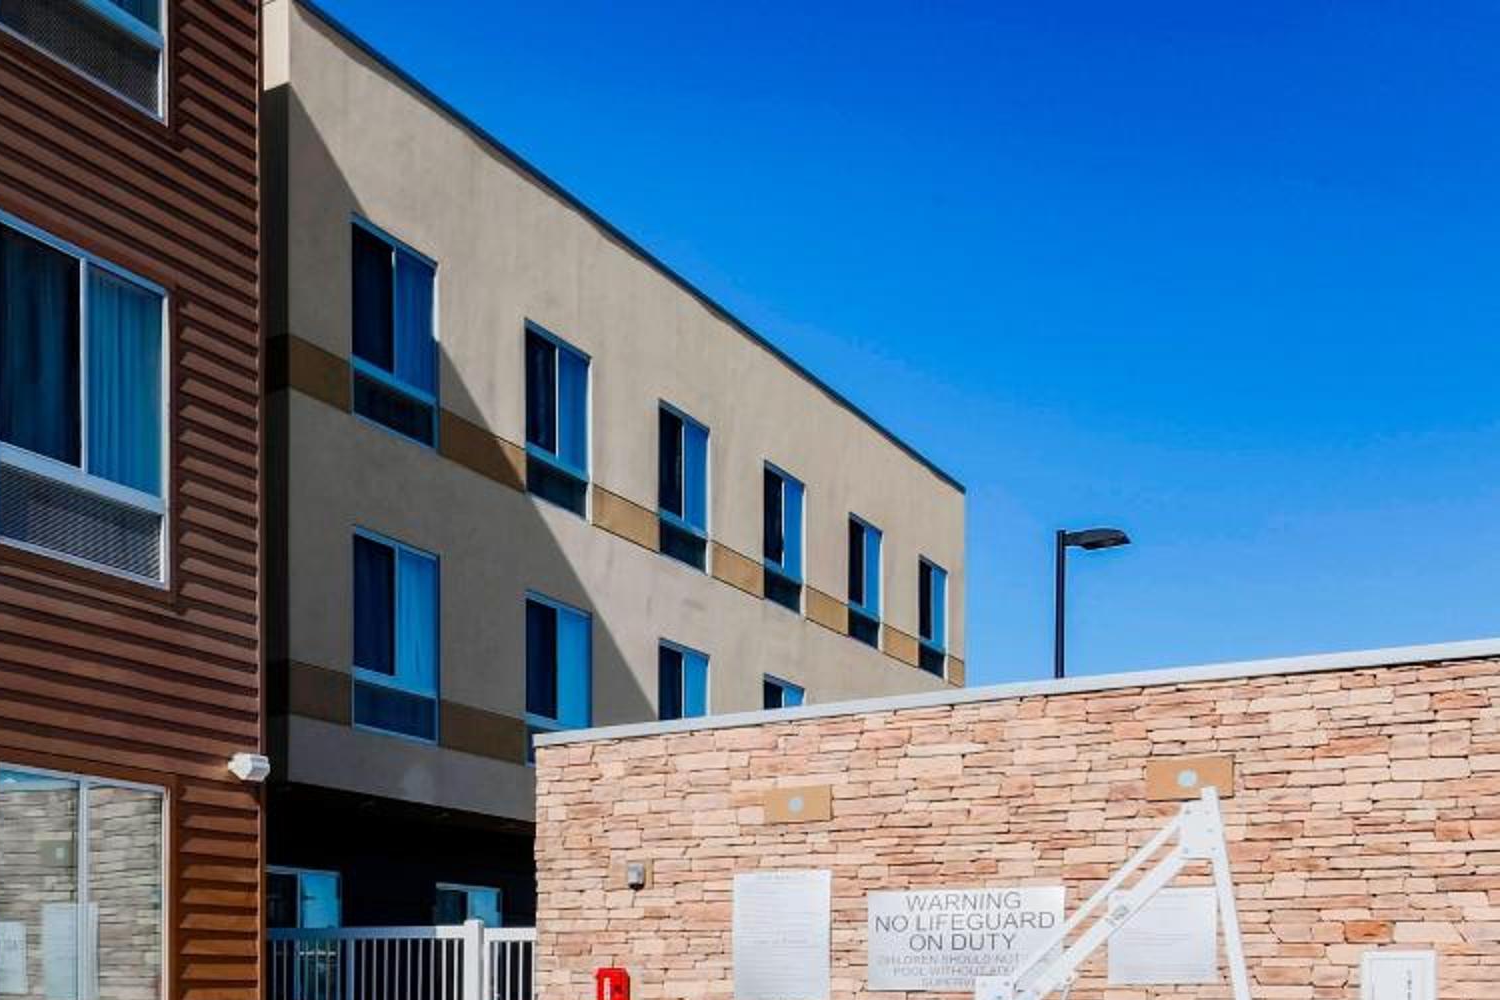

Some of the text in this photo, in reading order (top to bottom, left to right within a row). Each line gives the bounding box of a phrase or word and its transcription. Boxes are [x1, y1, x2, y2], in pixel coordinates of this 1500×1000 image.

[905, 891, 1021, 912] WARNING
[875, 911, 1055, 933] NO LIFEGUARD
[909, 933, 1016, 951] ON DUTY
